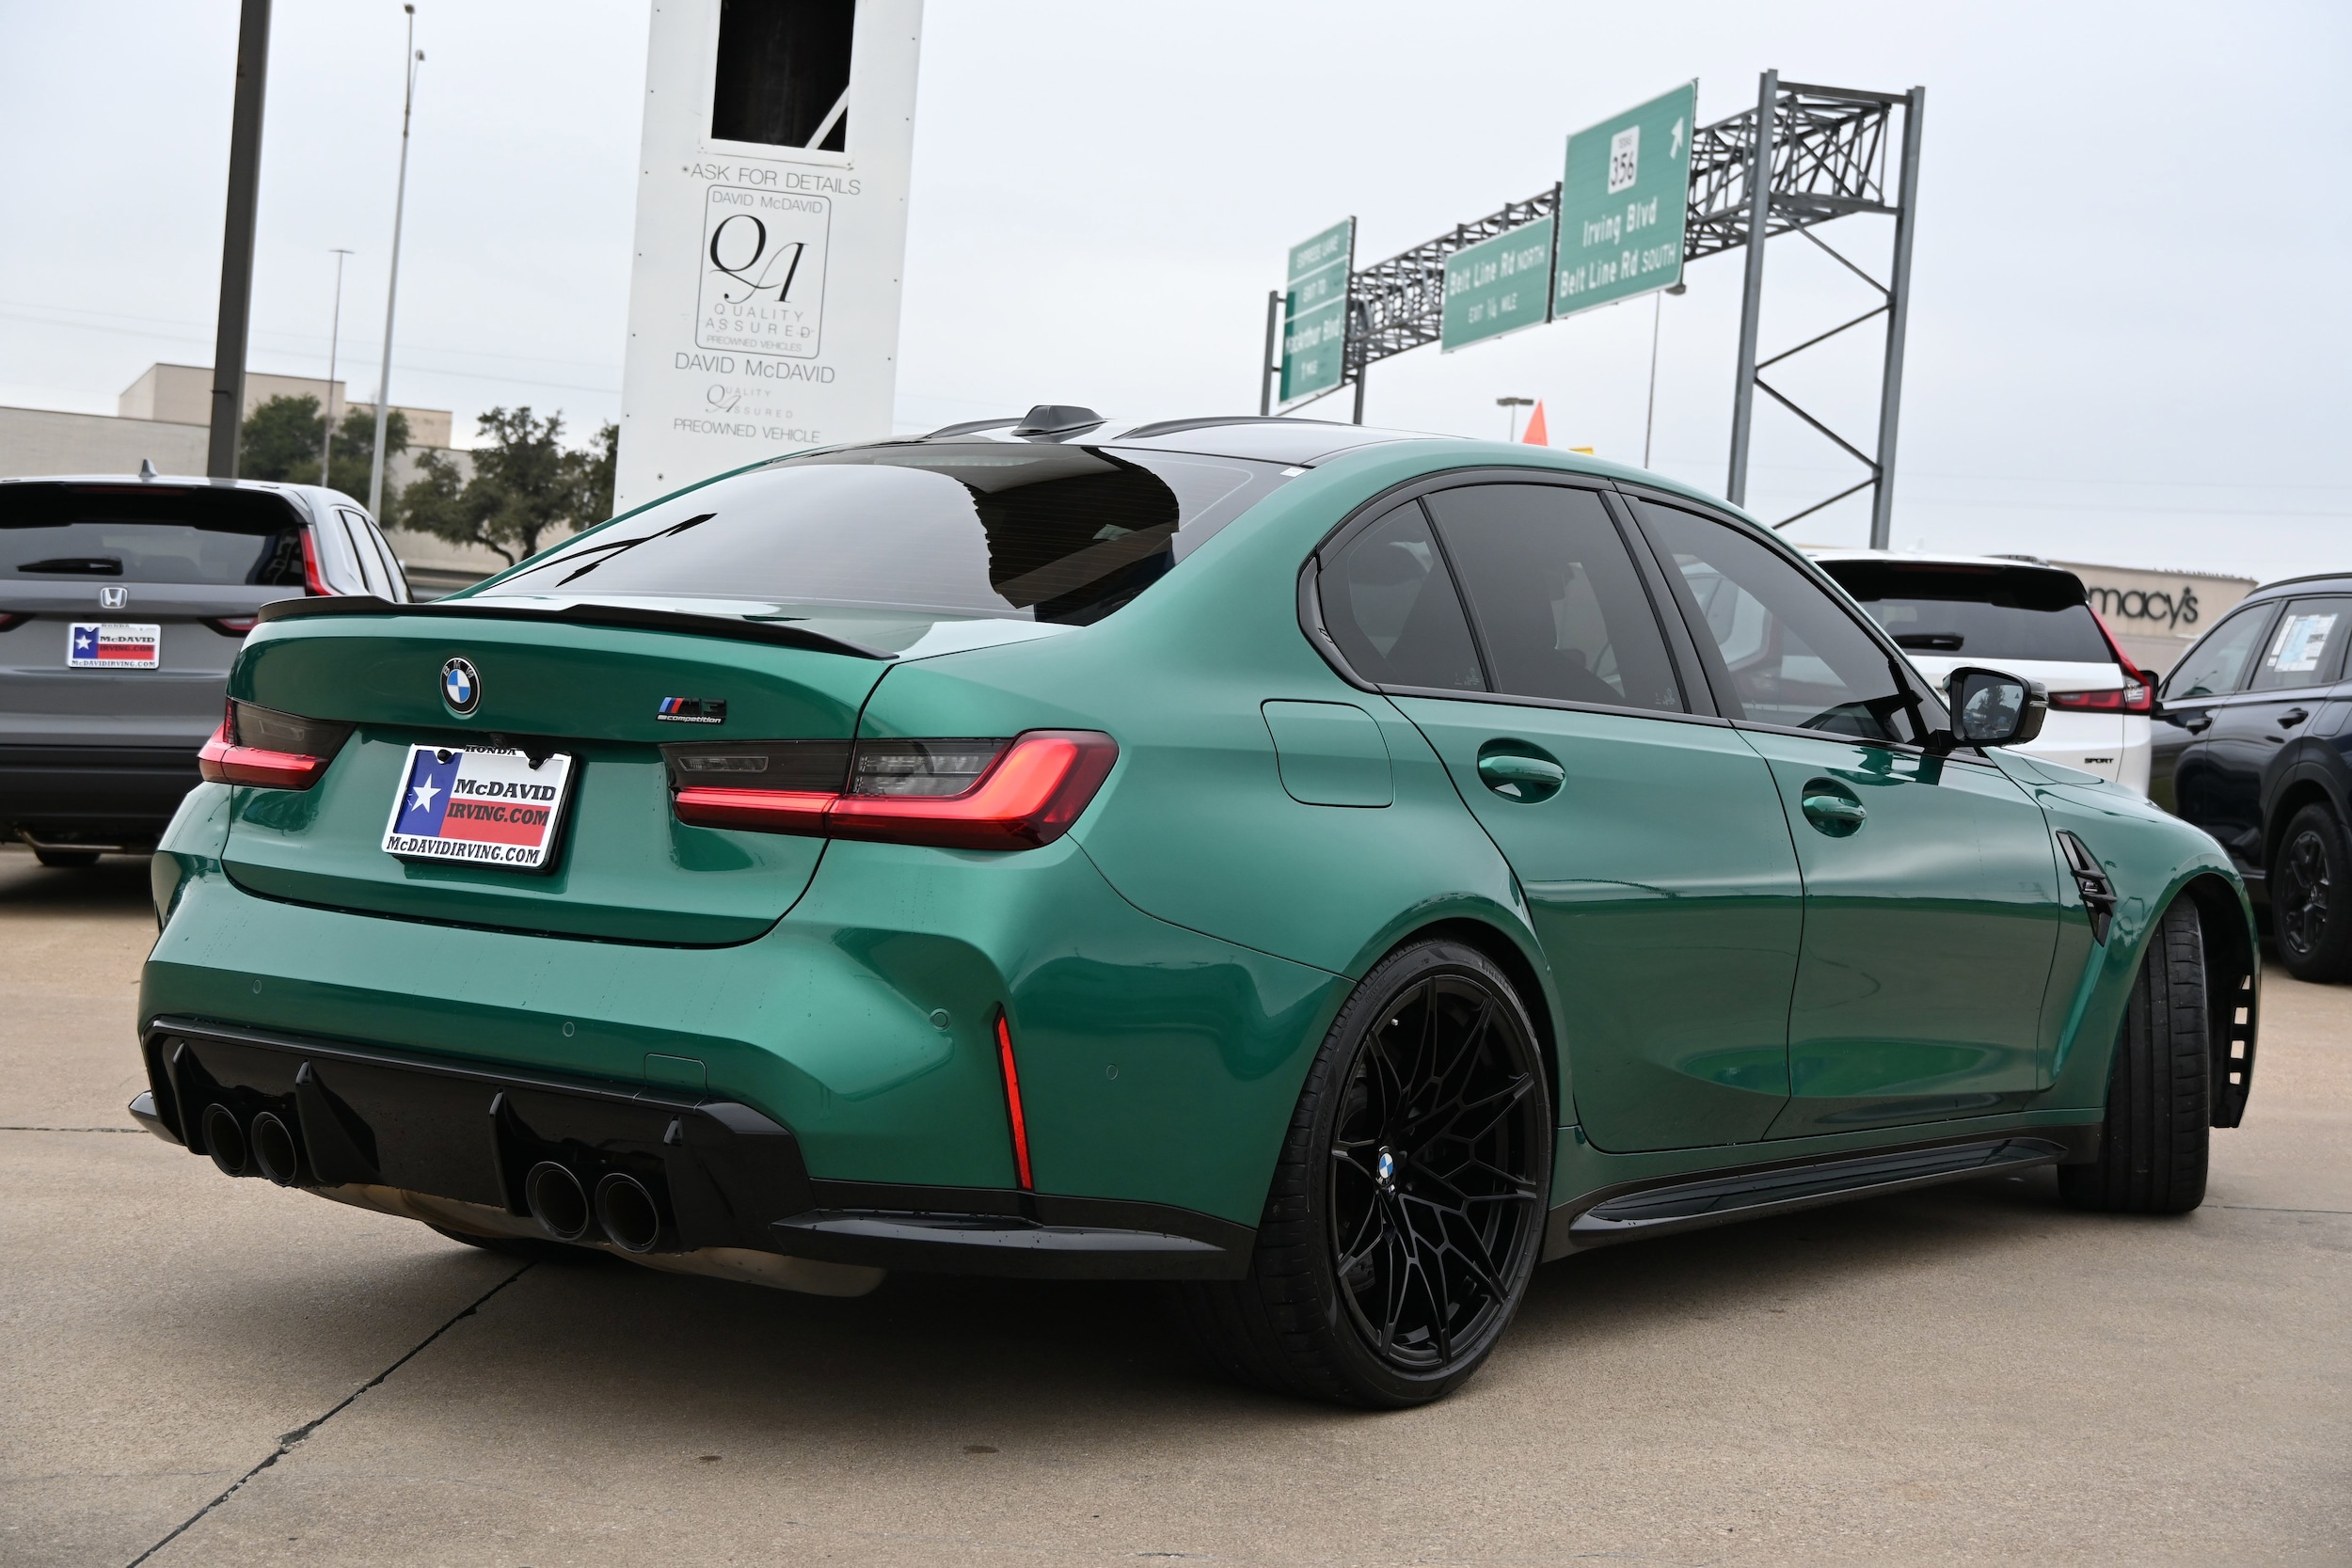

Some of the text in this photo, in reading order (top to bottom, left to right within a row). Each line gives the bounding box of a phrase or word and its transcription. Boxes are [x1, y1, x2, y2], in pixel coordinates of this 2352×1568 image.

[1610, 151, 1634, 186] 356
[739, 167, 777, 186] FOR
[787, 172, 861, 196] DETAILS
[712, 191, 823, 214] DAVID McDAVID
[1582, 197, 1658, 247] Irving Blvd
[1449, 245, 1546, 296] Belt Line Rd NORTH
[1560, 243, 1677, 298] Belt Line Rd SOUTH
[714, 303, 804, 322] QUALITY
[705, 318, 811, 339] ASSURED
[707, 335, 803, 353] PREOWNED VEHICLES
[675, 353, 835, 384] DAVID McDAVID
[674, 419, 821, 444] PREOWNED VEHICLE
[2089, 586, 2199, 629] macy's
[72, 659, 155, 668] McDAVIDIRVING.COM
[443, 659, 475, 679] BMW
[666, 715, 722, 724] competition
[464, 745, 517, 756] HONDA
[454, 779, 557, 801] McDAVID
[447, 802, 550, 827] IRVING.COM
[387, 836, 541, 864] McDAVIDIRVING.COM
